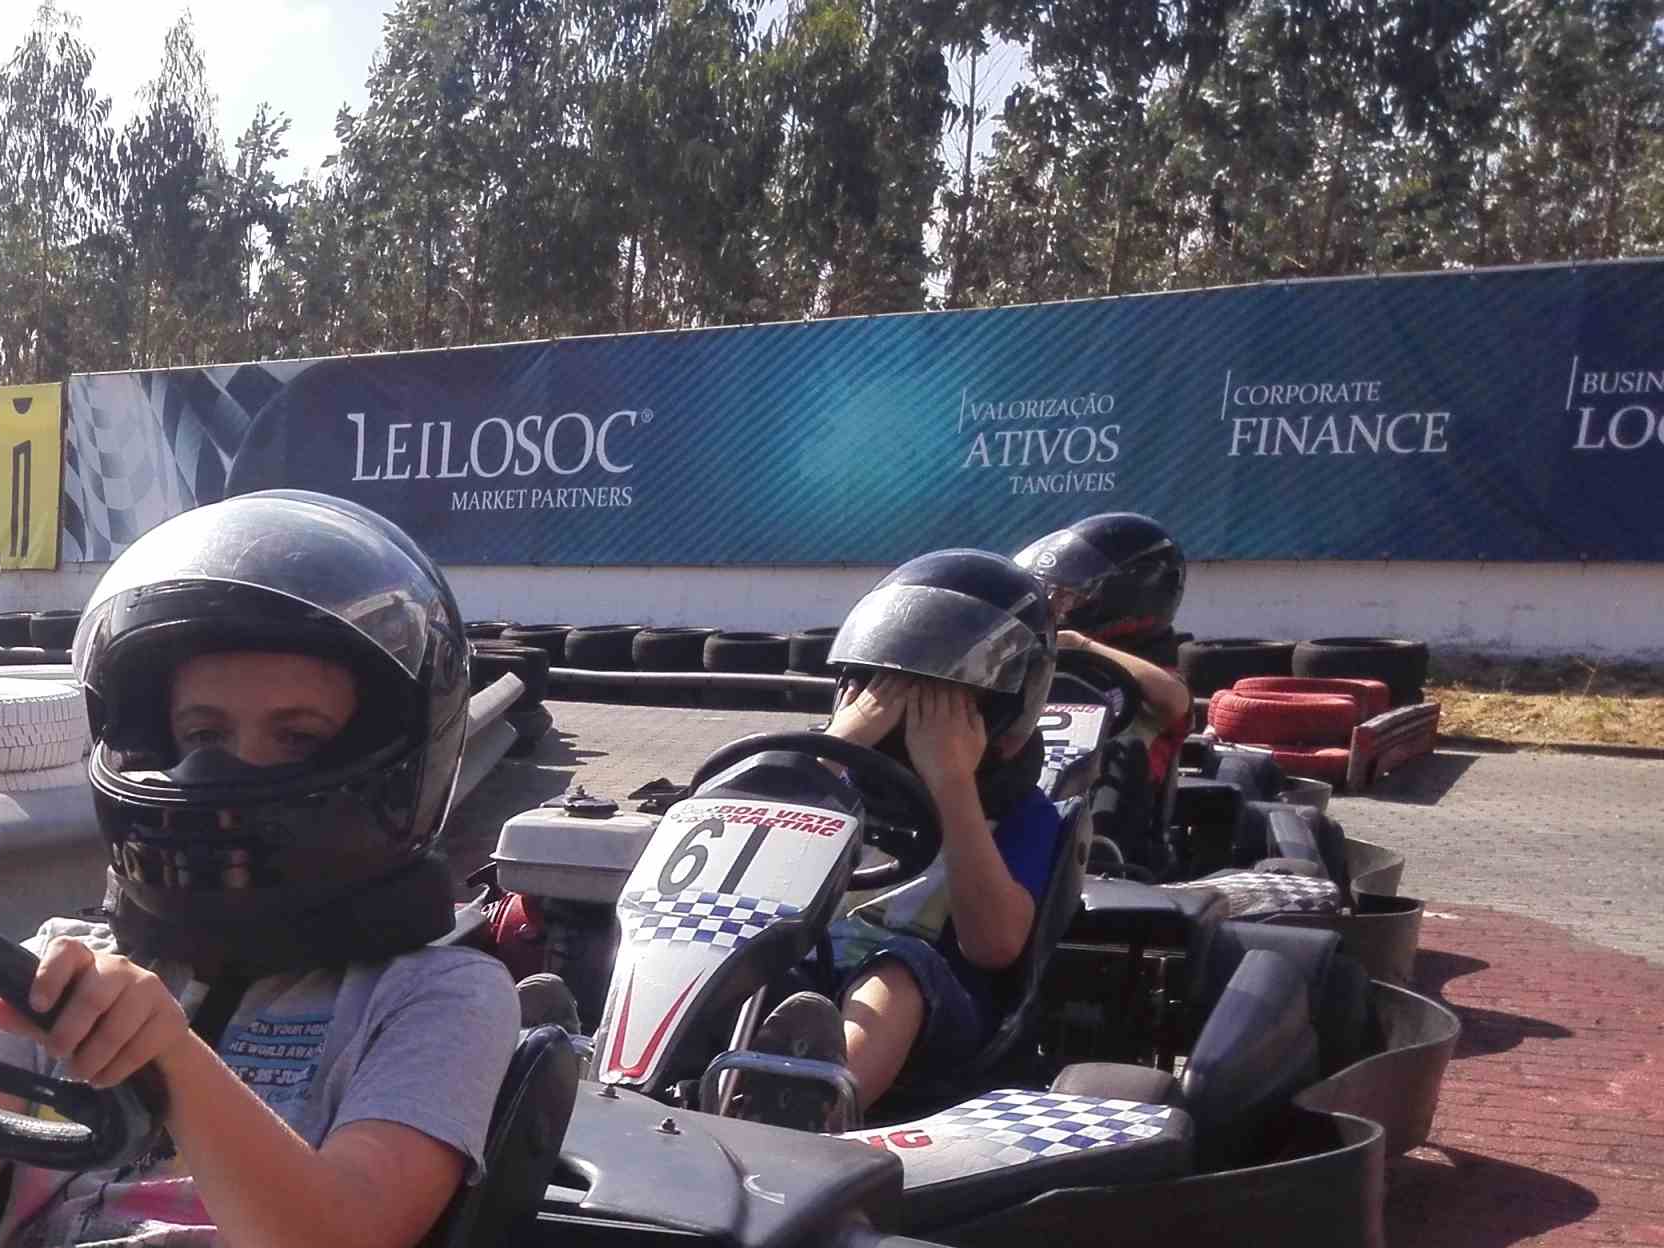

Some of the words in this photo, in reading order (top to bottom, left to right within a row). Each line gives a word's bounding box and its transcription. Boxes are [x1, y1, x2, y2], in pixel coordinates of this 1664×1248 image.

[970, 392, 1115, 421] VALORIZAÇÃO
[1233, 380, 1382, 406] CORPORATE
[1227, 412, 1451, 456] FINANCE
[1572, 405, 1664, 449] LO
[960, 424, 1121, 468] ATIVOS
[1009, 470, 1116, 495] TANGÍVEIS
[451, 488, 529, 511] MARKET
[530, 486, 633, 510] PARTNERS
[719, 805, 769, 817] BOA
[776, 809, 846, 830] VISTA
[727, 815, 837, 837] KARTING
[657, 818, 771, 896] 61
